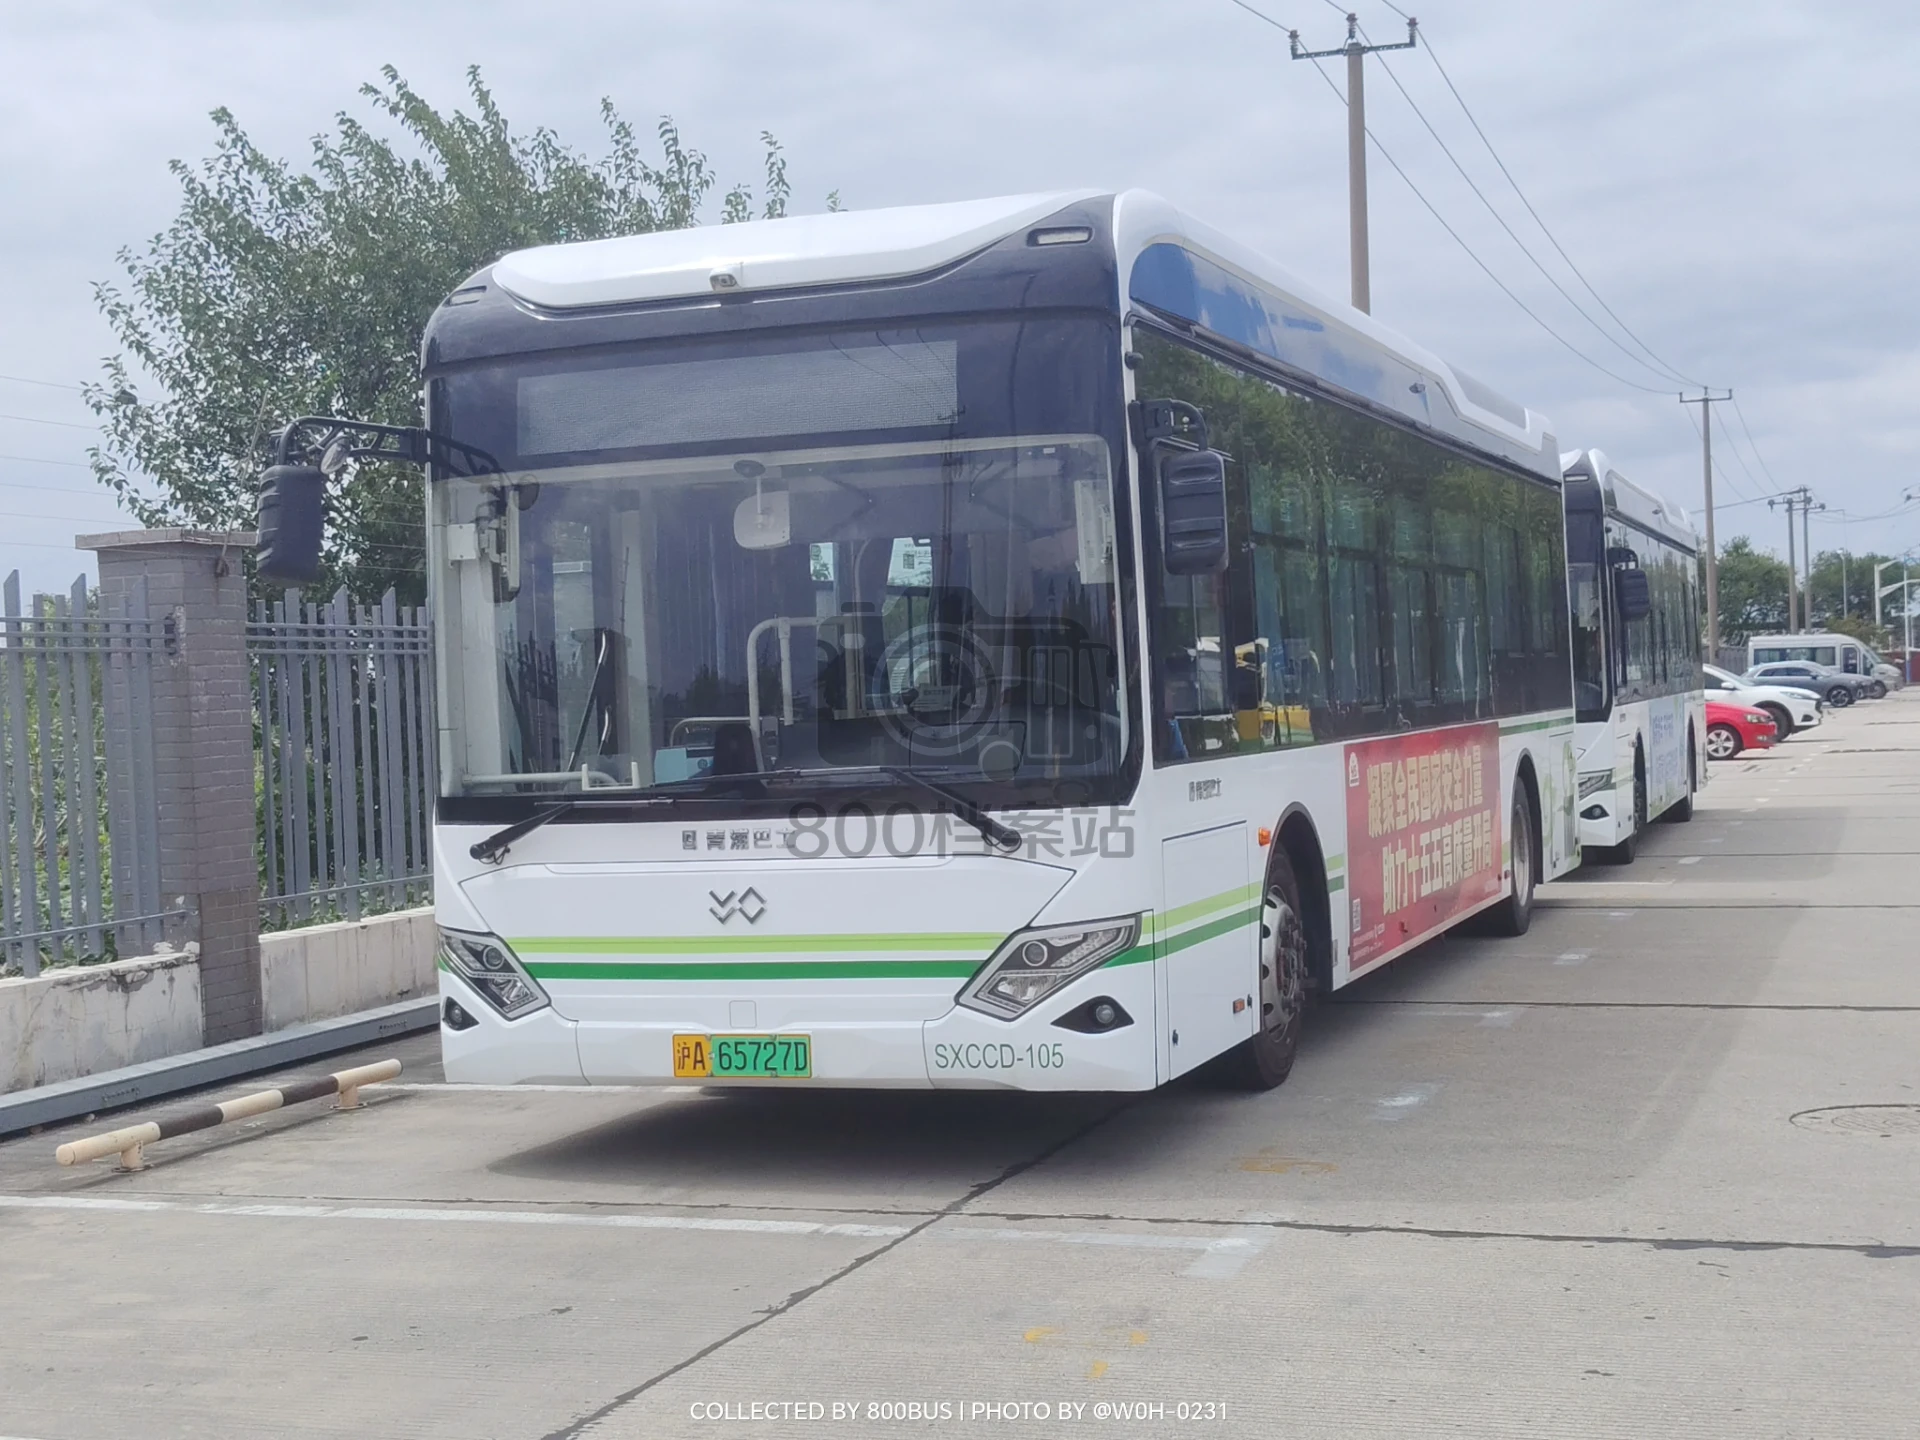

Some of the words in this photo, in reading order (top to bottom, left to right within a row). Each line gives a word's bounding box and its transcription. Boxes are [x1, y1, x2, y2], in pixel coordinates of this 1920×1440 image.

[1367, 745, 1483, 838] 凝聚全民国家安全力量
[1383, 809, 1492, 916] 助力十五五高质量开局
[677, 1041, 706, 1071] 沪A
[718, 1041, 808, 1071] 65727D
[934, 1043, 1064, 1069] SXCCD-105
